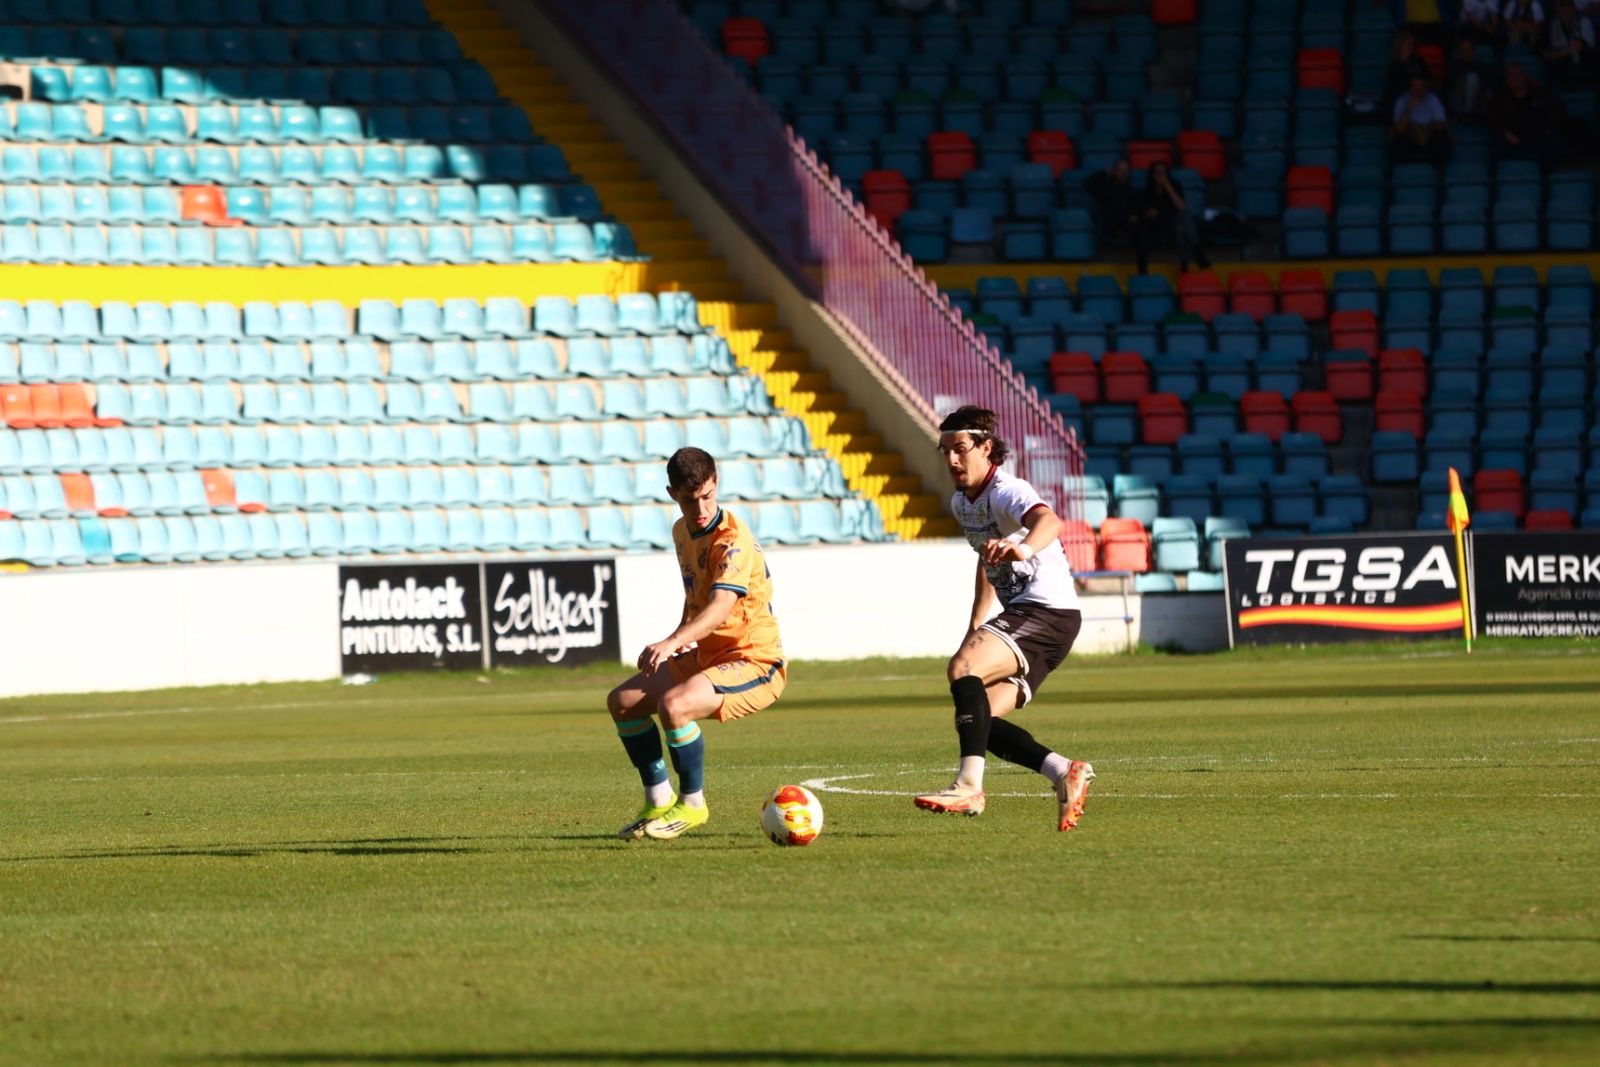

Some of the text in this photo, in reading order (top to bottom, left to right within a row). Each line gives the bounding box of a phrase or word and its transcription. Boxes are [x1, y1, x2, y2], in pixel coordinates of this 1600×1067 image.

[1245, 545, 1458, 593] TGSA
[1505, 554, 1600, 583] MERK
[341, 577, 466, 621] Autolack
[342, 624, 443, 658] PINTURAS,
[446, 623, 481, 652] S.L.
